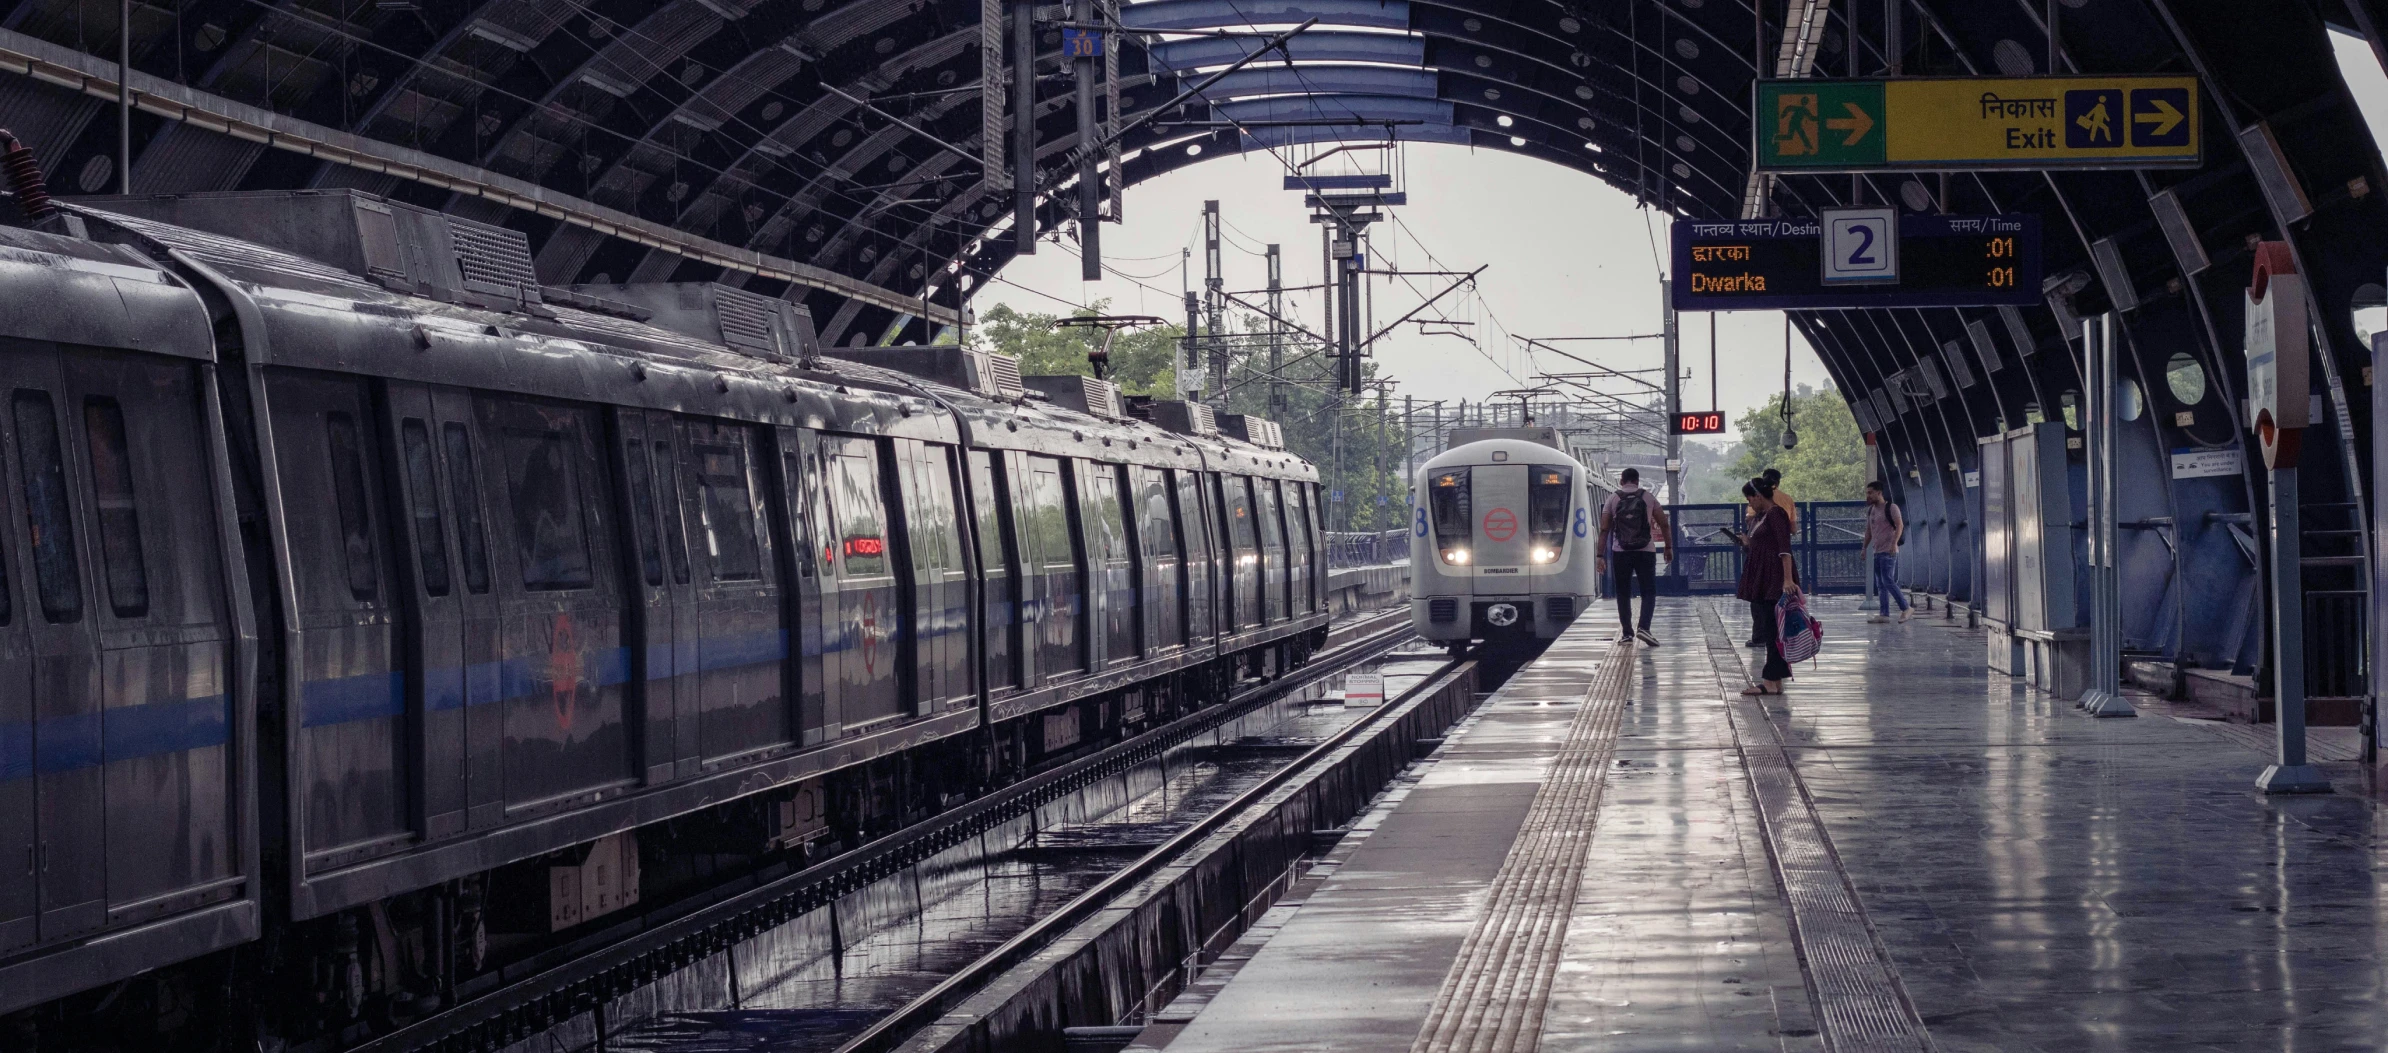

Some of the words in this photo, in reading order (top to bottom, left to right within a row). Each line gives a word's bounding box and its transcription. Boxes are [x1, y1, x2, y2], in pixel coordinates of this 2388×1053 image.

[1072, 39, 1093, 55] 30
[1979, 92, 2057, 119] निकास
[2006, 127, 2056, 149] Exit
[1692, 223, 1735, 236] गन्तव्य
[1848, 225, 1875, 264] 2
[1692, 272, 1766, 292] Dwarka
[1682, 415, 1719, 431] 10:10
[1415, 507, 1429, 538] 8
[1573, 507, 1587, 538] 8
